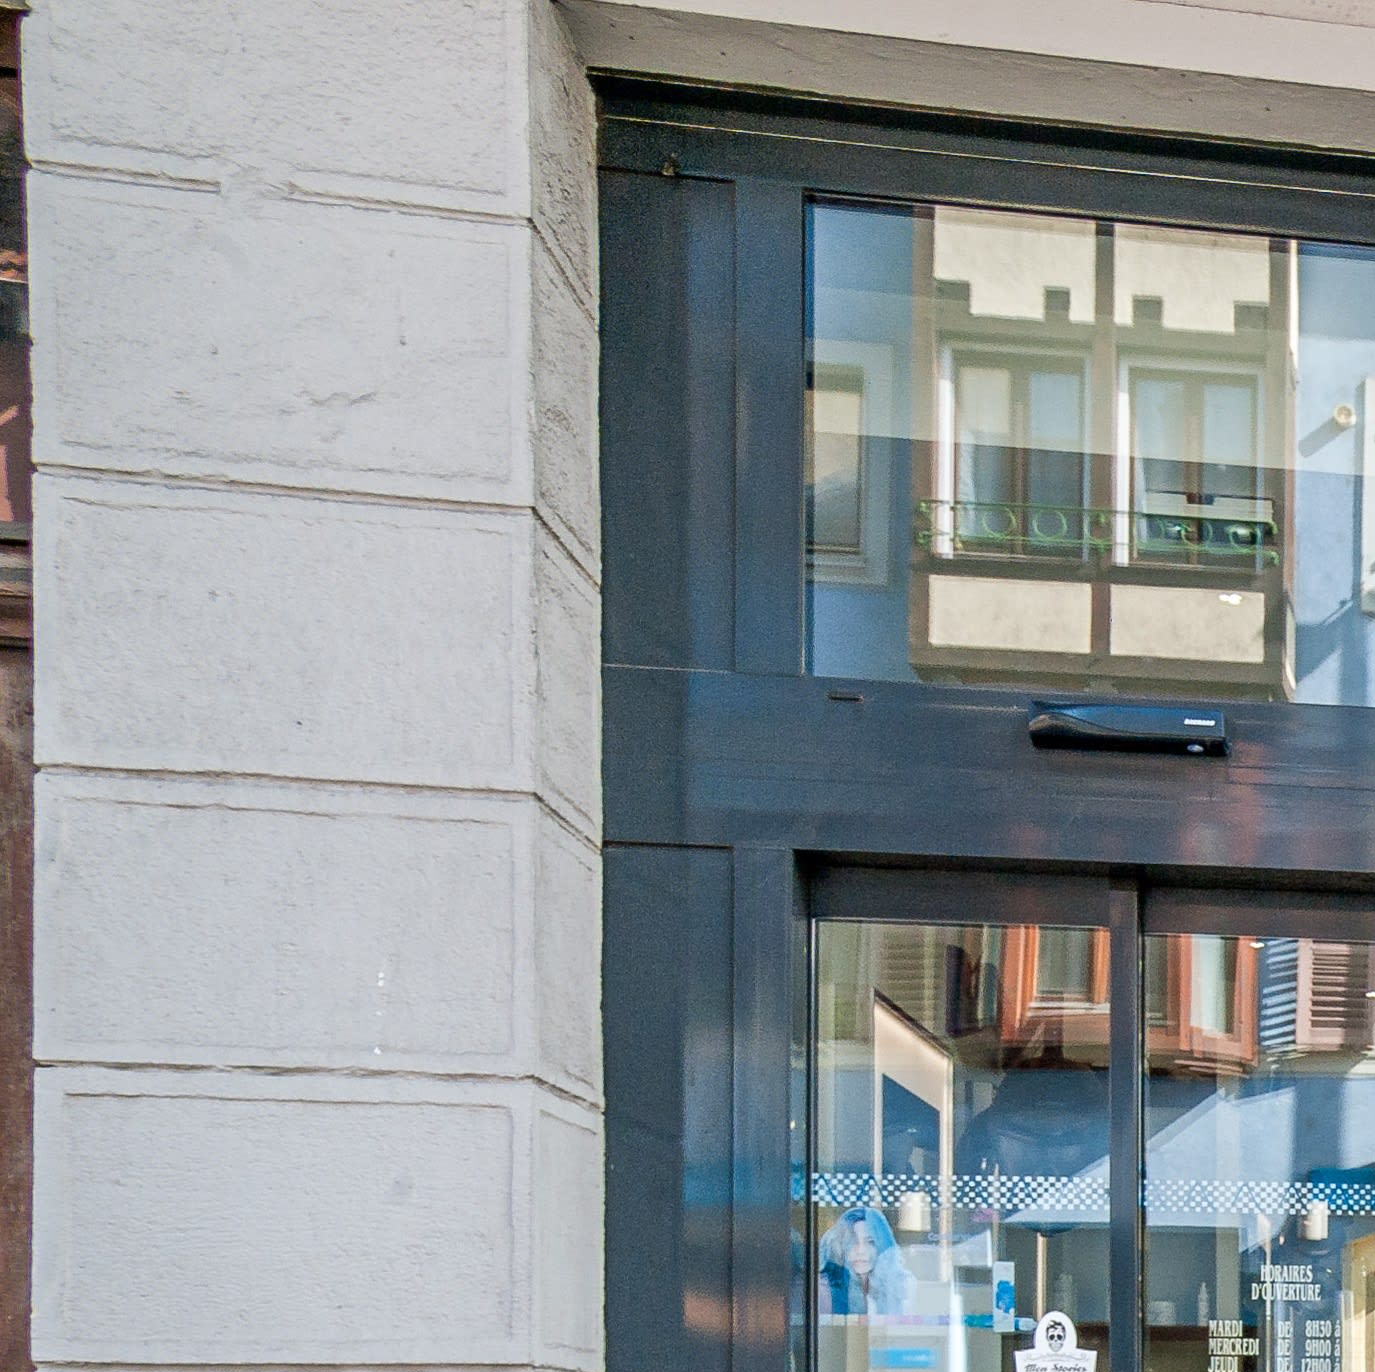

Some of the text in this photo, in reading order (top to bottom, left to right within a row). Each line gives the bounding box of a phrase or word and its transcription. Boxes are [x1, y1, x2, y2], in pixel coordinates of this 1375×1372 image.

[1260, 1265, 1313, 1283] HORAIRES
[1251, 1283, 1321, 1301] D'OUVERTURE
[1208, 1320, 1243, 1338] MARDI
[1279, 1321, 1291, 1338] DE
[1305, 1320, 1332, 1338] 8H30
[1208, 1338, 1260, 1356] MERCREDI
[1278, 1339, 1290, 1356] DE
[1305, 1338, 1332, 1356] 9H00
